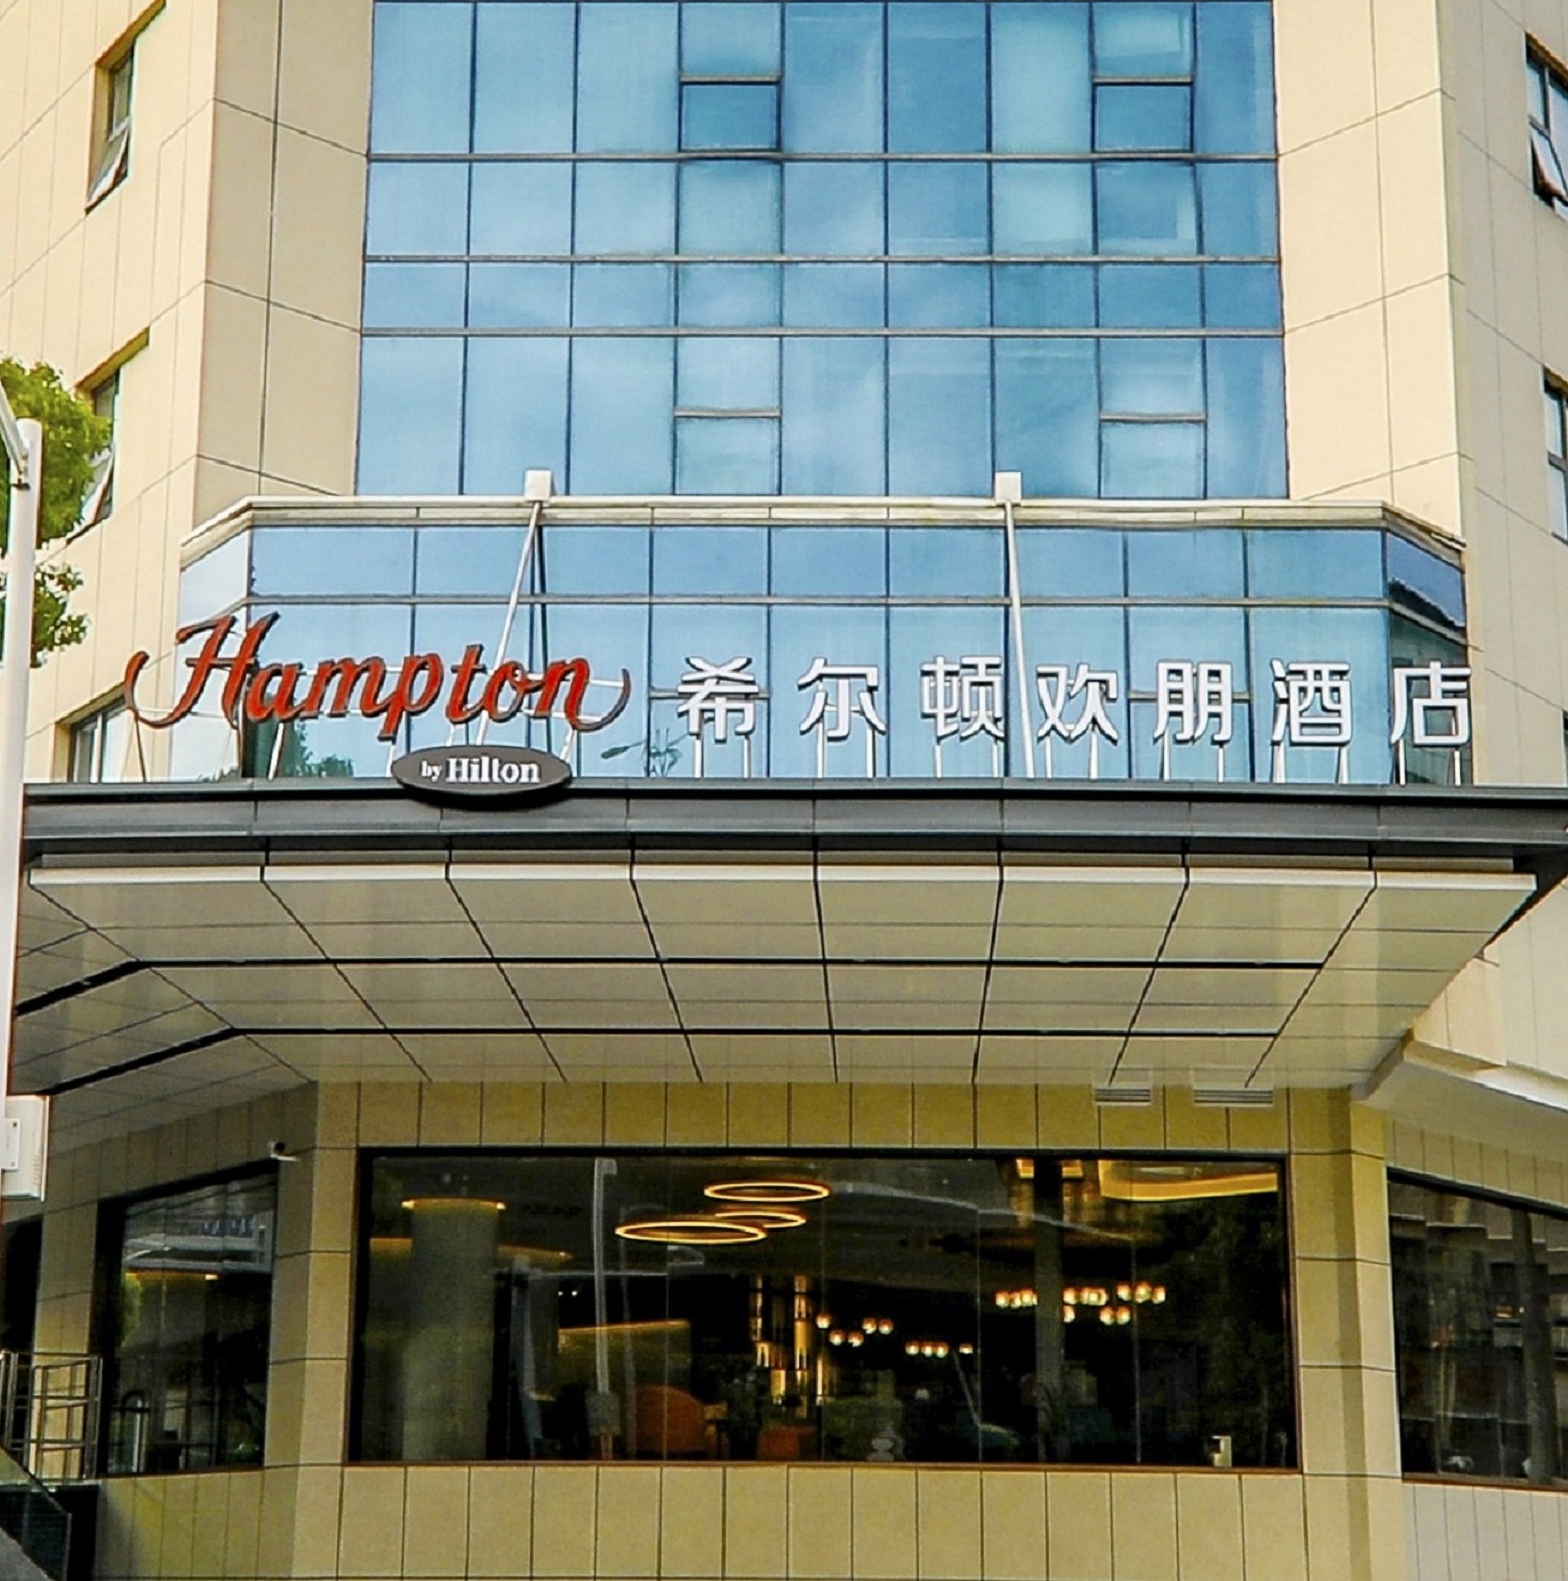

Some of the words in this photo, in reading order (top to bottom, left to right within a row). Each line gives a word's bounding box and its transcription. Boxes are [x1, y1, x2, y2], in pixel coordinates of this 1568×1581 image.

[123, 611, 632, 742] Hampton
[676, 655, 1473, 749] 希尔顿欢朋酒店
[420, 760, 442, 783] by
[445, 755, 541, 784] Hilton
